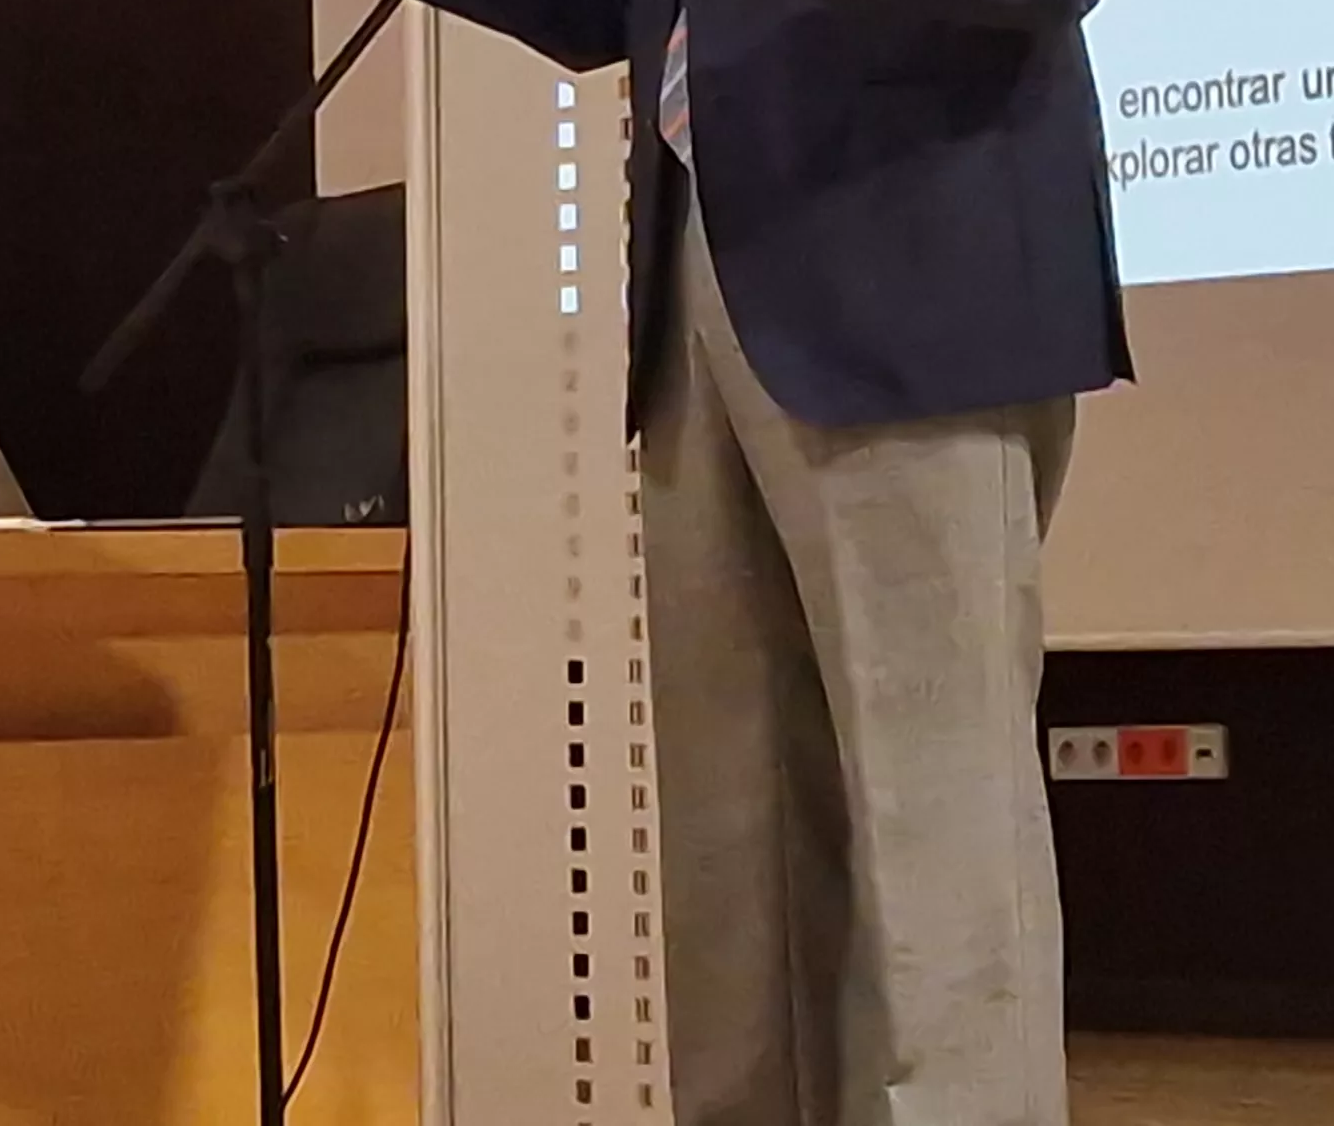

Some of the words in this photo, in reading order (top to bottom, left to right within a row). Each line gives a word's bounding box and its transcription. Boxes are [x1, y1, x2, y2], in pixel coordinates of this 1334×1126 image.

[1119, 69, 1286, 119] encontrar
[1108, 138, 1220, 192] xplorar
[1229, 128, 1318, 171] otras
